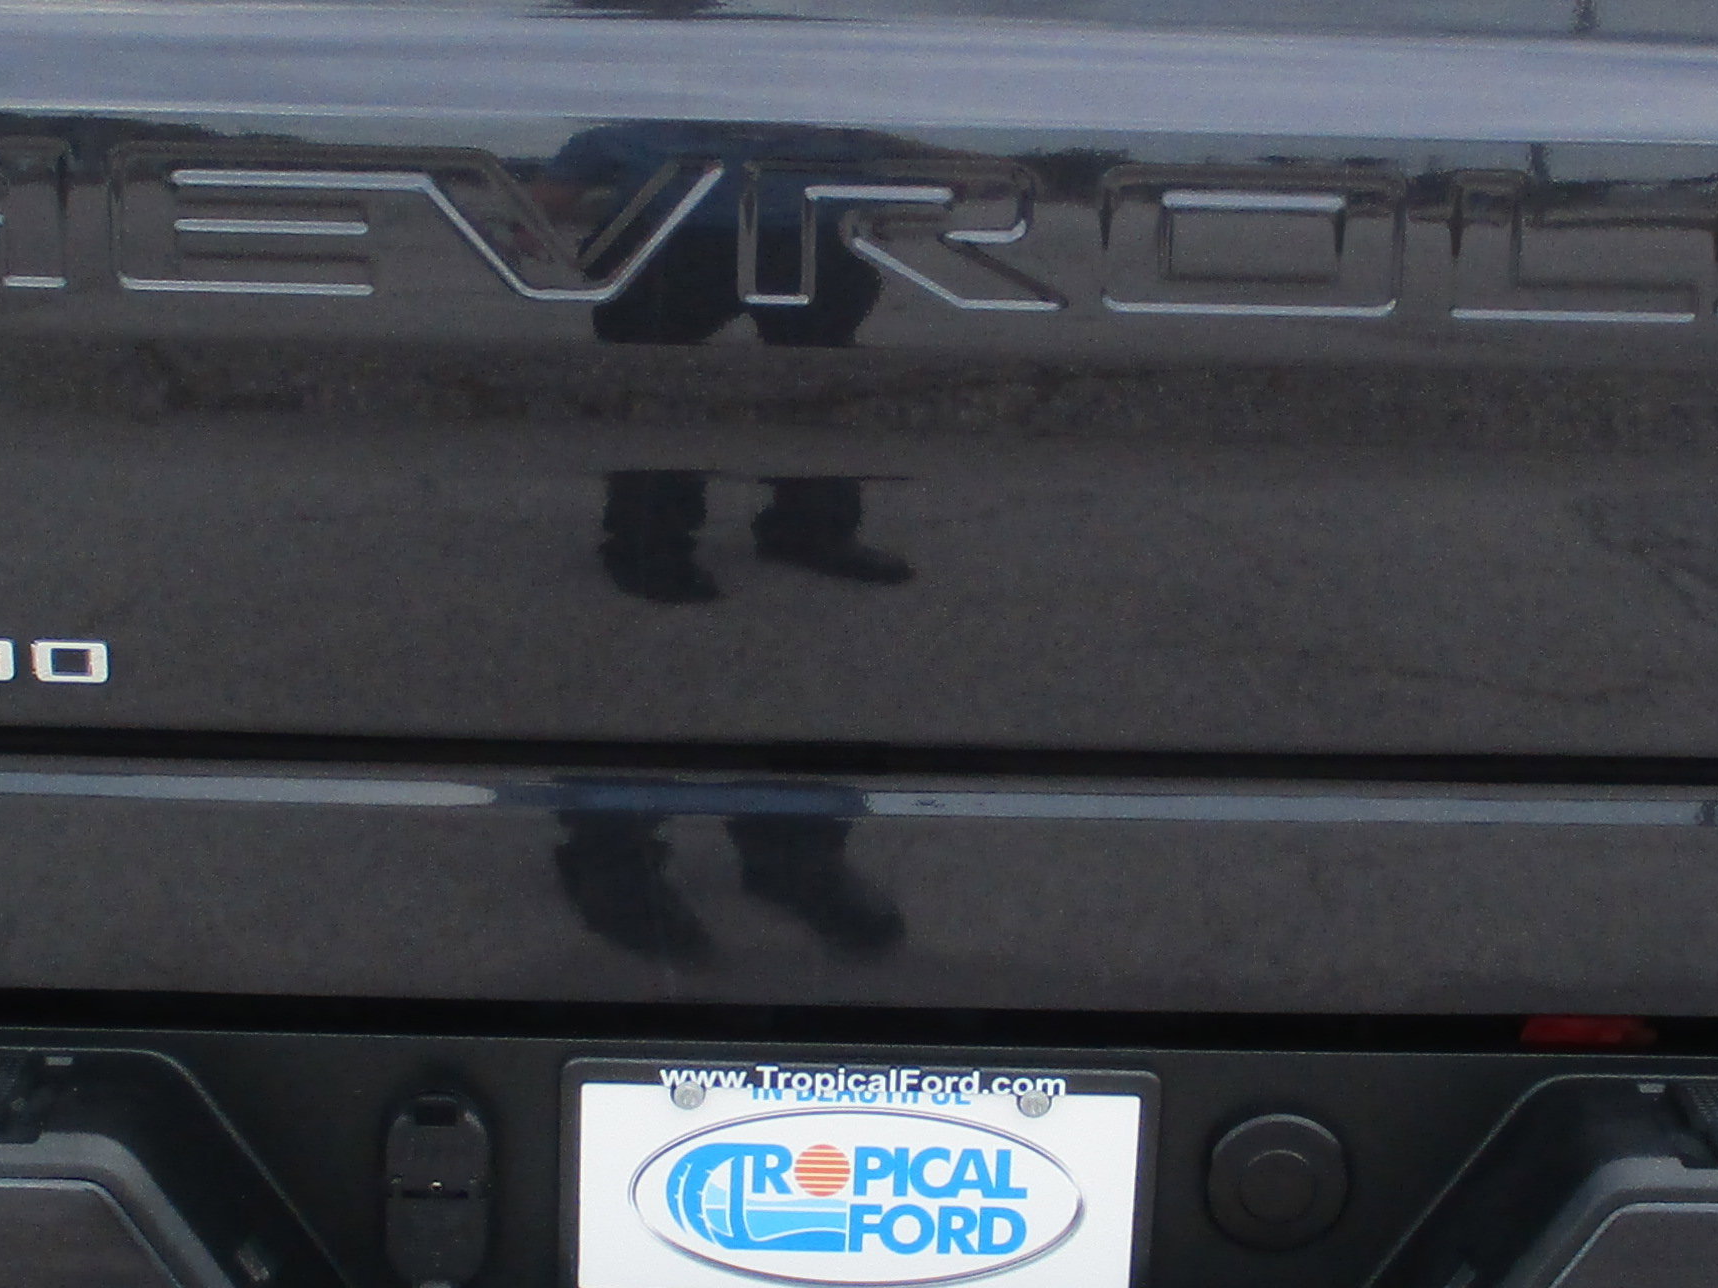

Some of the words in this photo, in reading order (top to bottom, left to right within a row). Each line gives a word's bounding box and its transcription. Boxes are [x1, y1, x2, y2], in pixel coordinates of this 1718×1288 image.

[659, 1065, 1067, 1098] www.TropicalFord.com
[666, 1142, 1028, 1200] TROPICAL
[848, 1203, 1028, 1255] FORD
